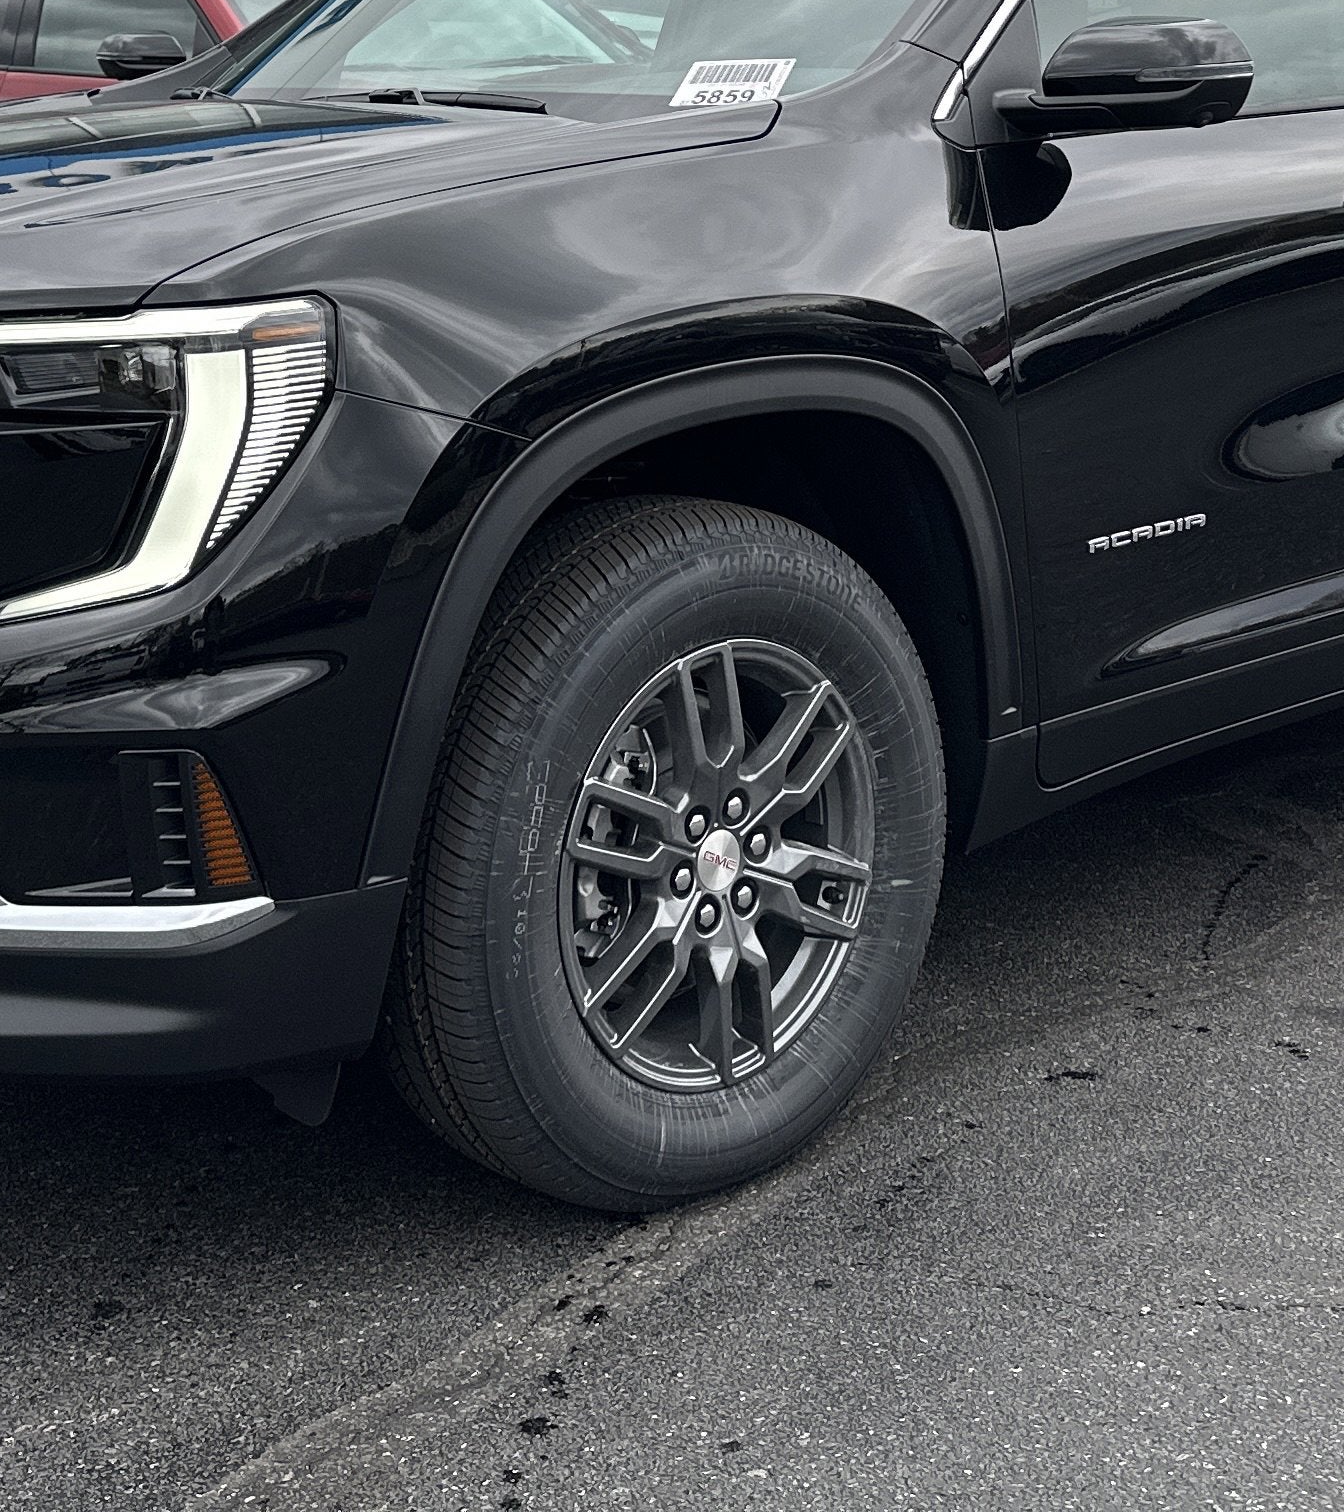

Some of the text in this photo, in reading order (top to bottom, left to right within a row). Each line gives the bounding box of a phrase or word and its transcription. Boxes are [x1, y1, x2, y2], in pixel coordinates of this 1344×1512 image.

[690, 89, 756, 105] 5859
[1087, 513, 1207, 554] ACADIA
[703, 850, 737, 872] GMC
